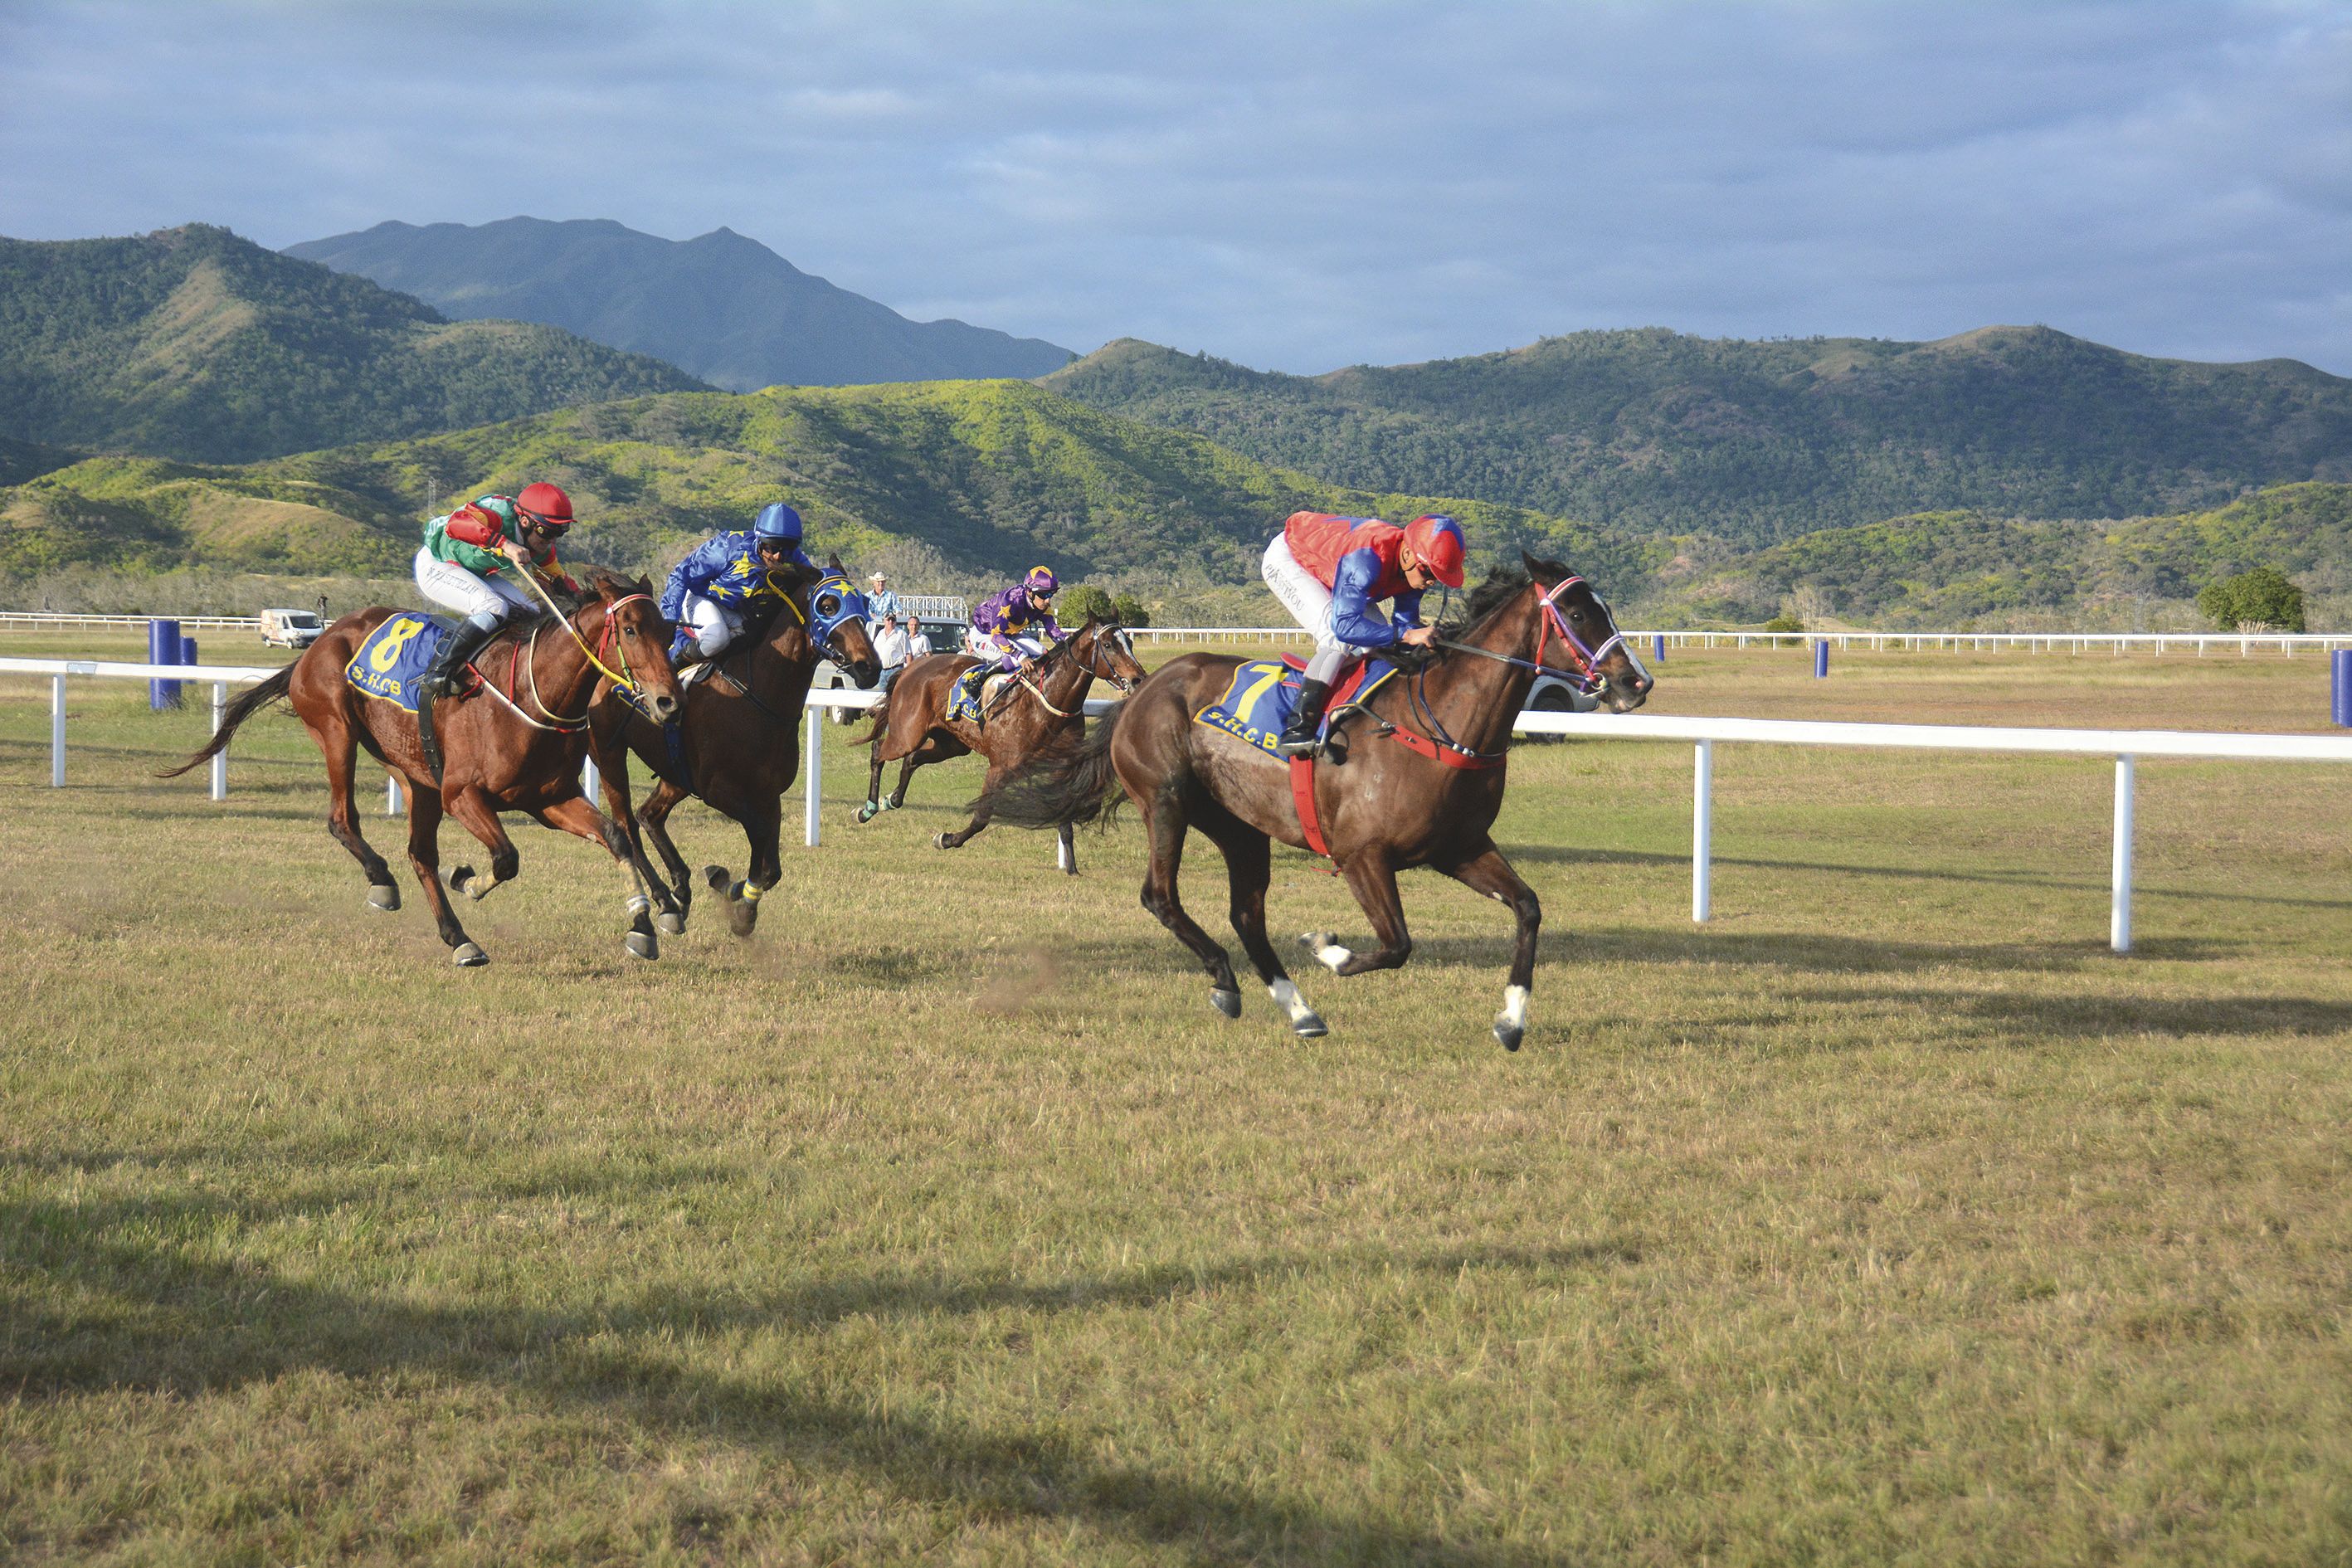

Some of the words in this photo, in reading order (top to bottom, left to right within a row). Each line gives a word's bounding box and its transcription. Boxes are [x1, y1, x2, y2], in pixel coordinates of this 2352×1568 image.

[370, 618, 425, 673] 8
[351, 665, 402, 695] S.H.C.B
[1249, 665, 1289, 723] 7
[1208, 711, 1278, 750] S.H.C.B
